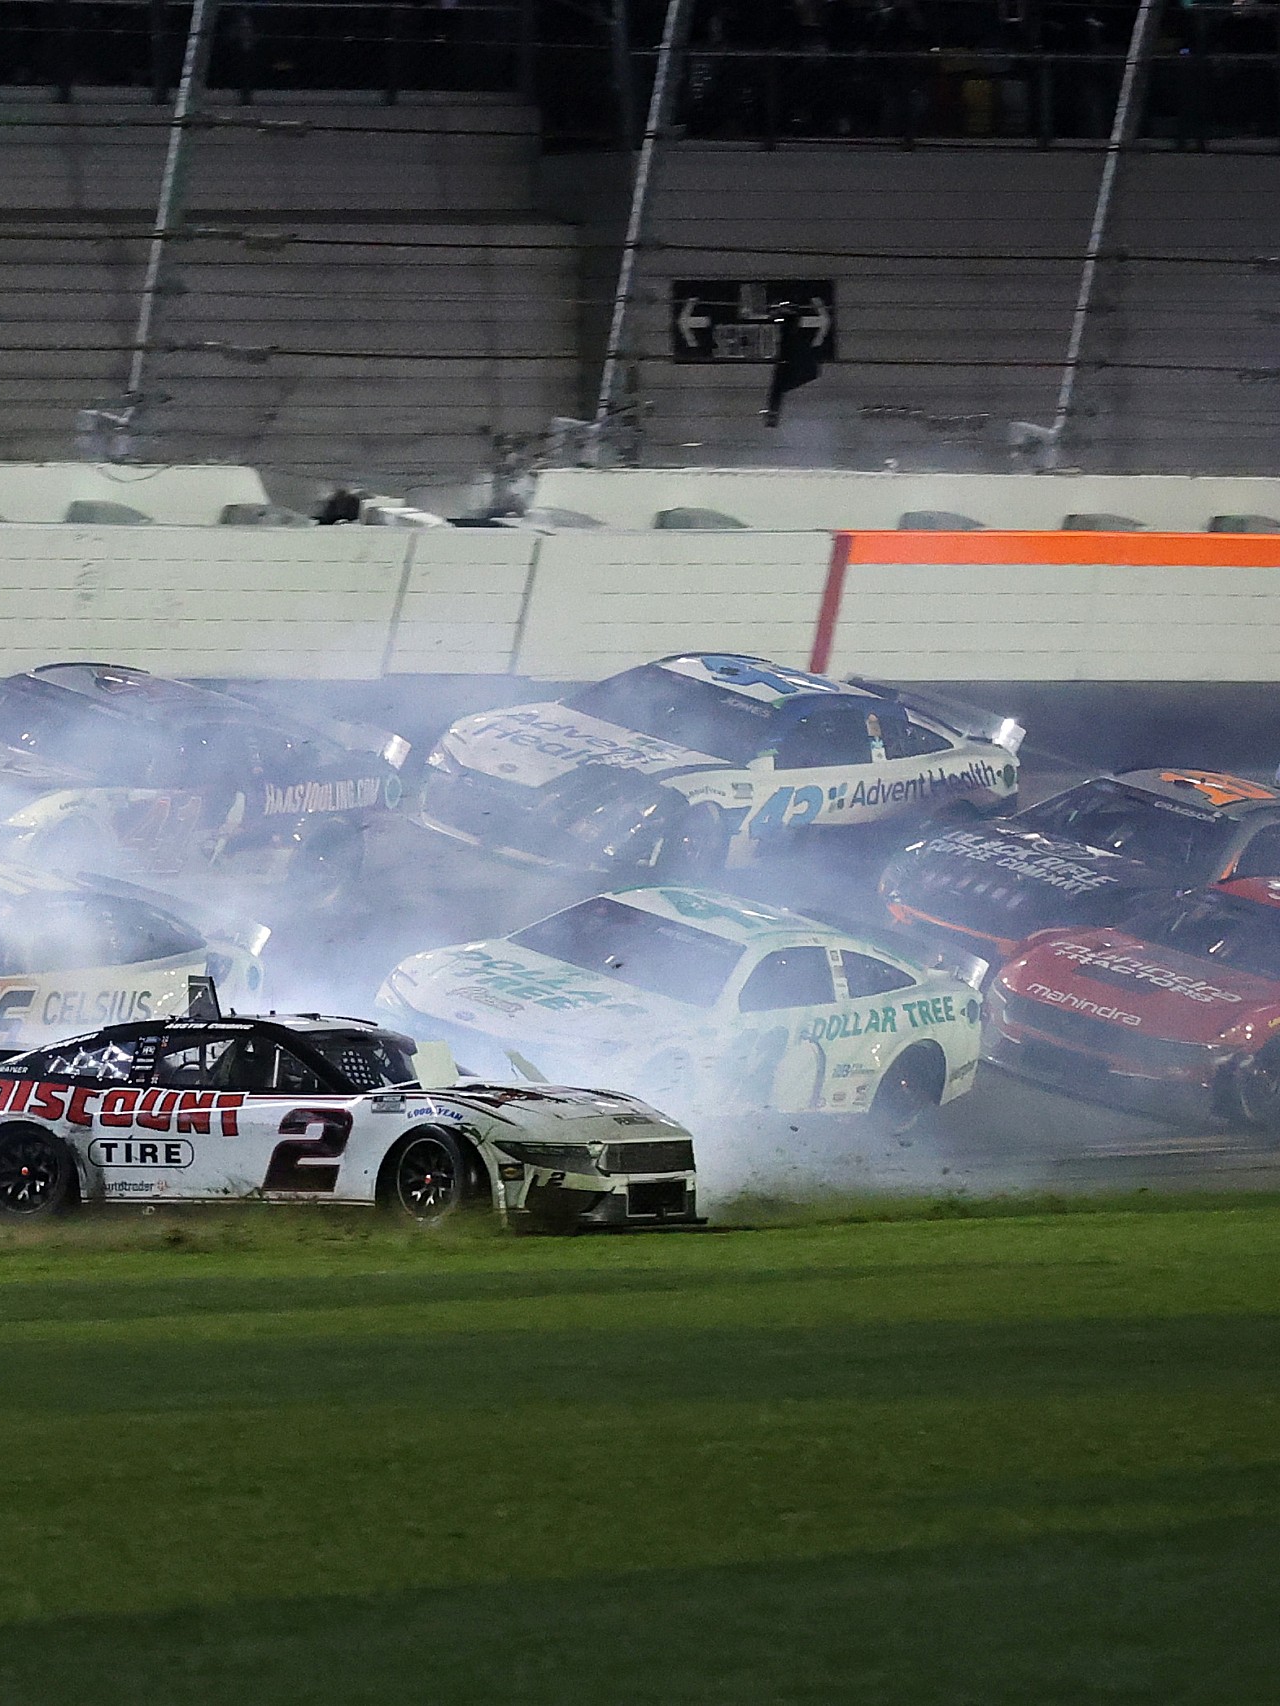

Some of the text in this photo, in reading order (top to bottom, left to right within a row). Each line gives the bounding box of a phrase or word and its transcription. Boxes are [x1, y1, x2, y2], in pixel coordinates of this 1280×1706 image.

[42, 989, 153, 1026] CELSIUS
[810, 995, 956, 1041] DOLLAR TREE
[1027, 982, 1143, 1027] mahindra
[99, 1142, 182, 1164] TIRE
[261, 1108, 354, 1193] 2
